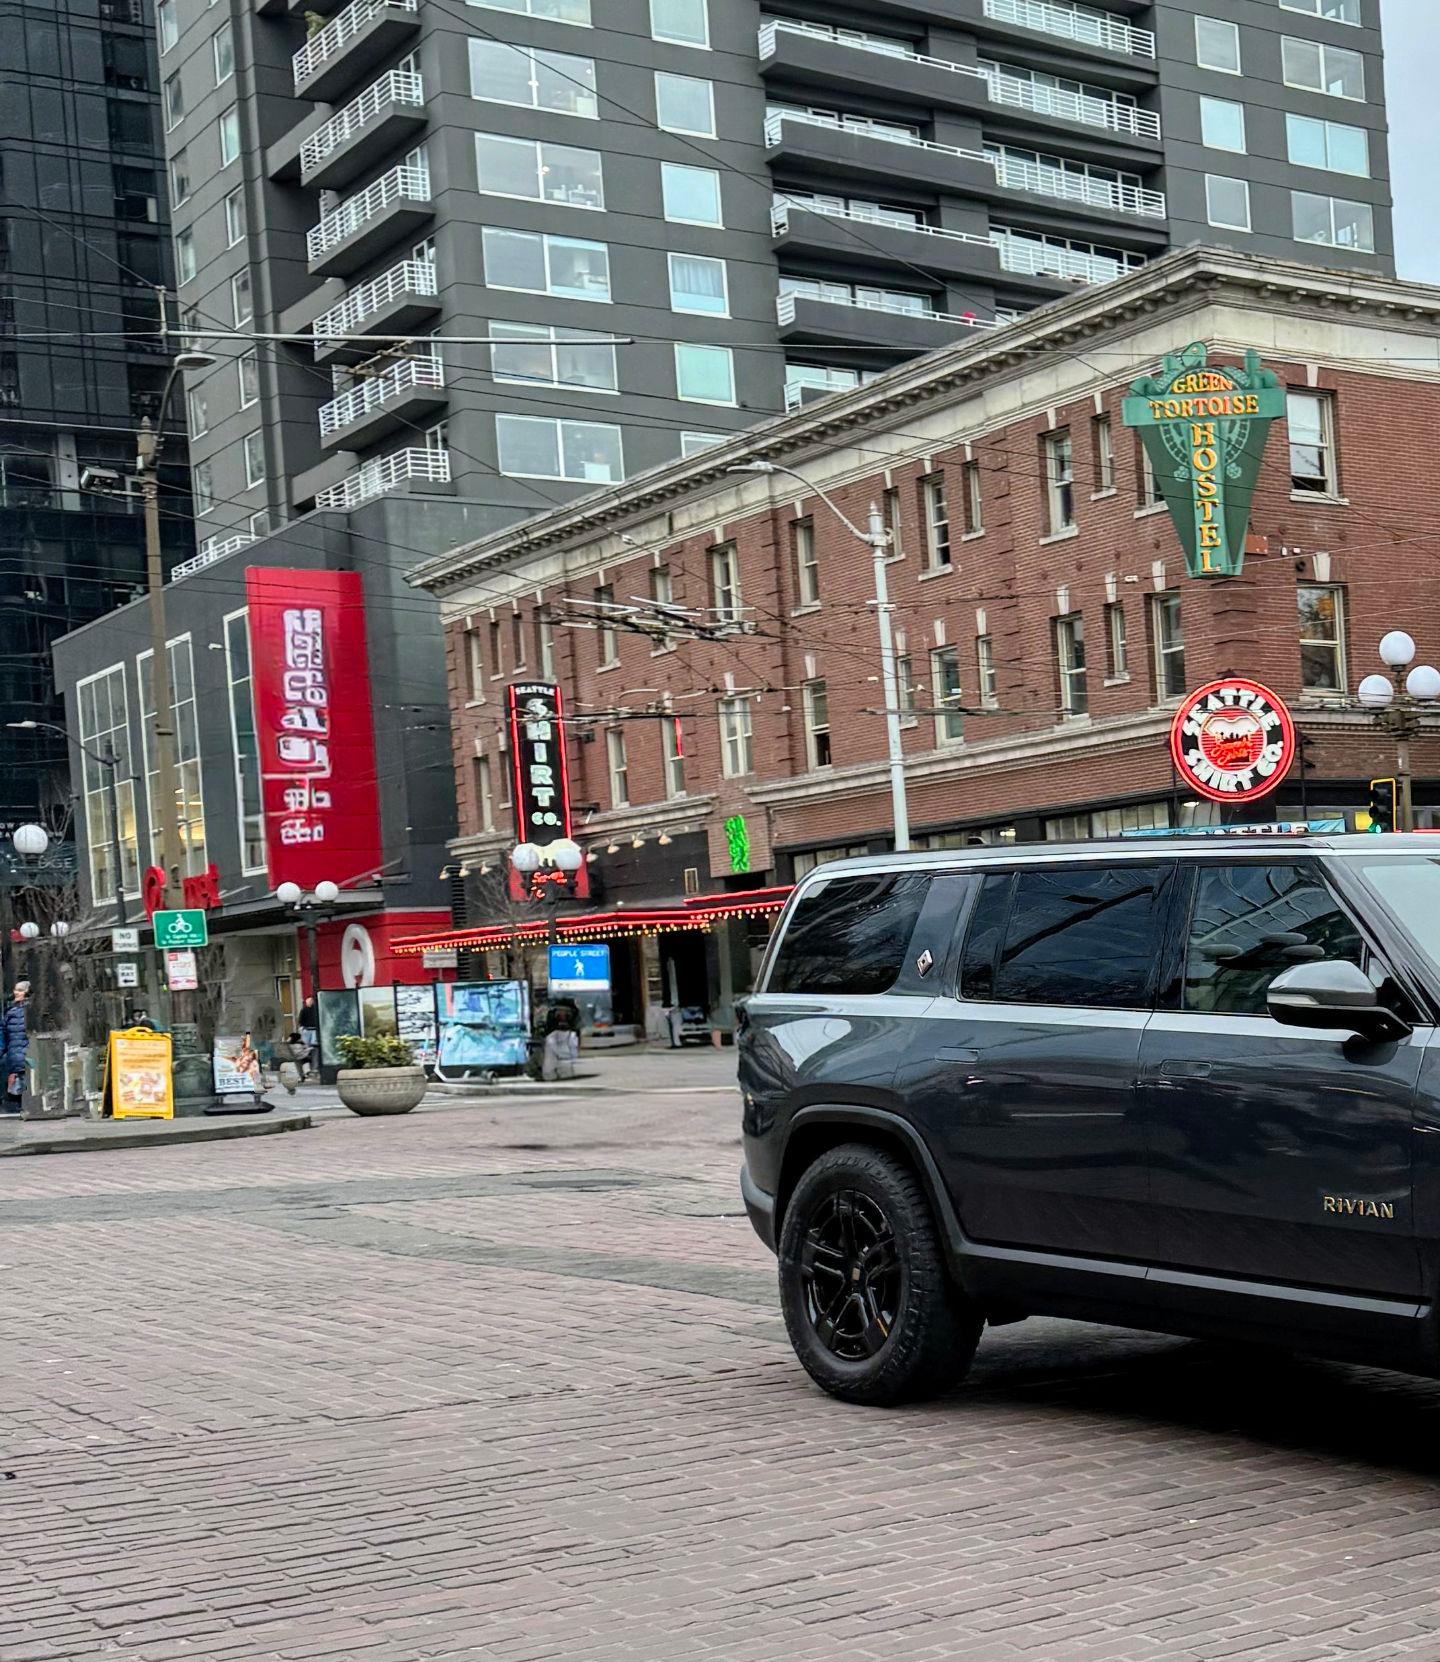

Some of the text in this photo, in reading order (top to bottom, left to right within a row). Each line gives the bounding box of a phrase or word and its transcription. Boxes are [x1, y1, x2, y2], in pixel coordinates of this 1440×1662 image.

[1171, 372, 1233, 394] GREEN
[1149, 394, 1260, 419] TORTOISE
[1191, 422, 1222, 573] HOSTEL
[515, 685, 555, 697] SEATTLE
[1182, 688, 1281, 736] SEATTLE
[1183, 748, 1254, 792] SHIRT
[119, 932, 132, 940] NO
[1323, 1196, 1394, 1219] RIVIAN
